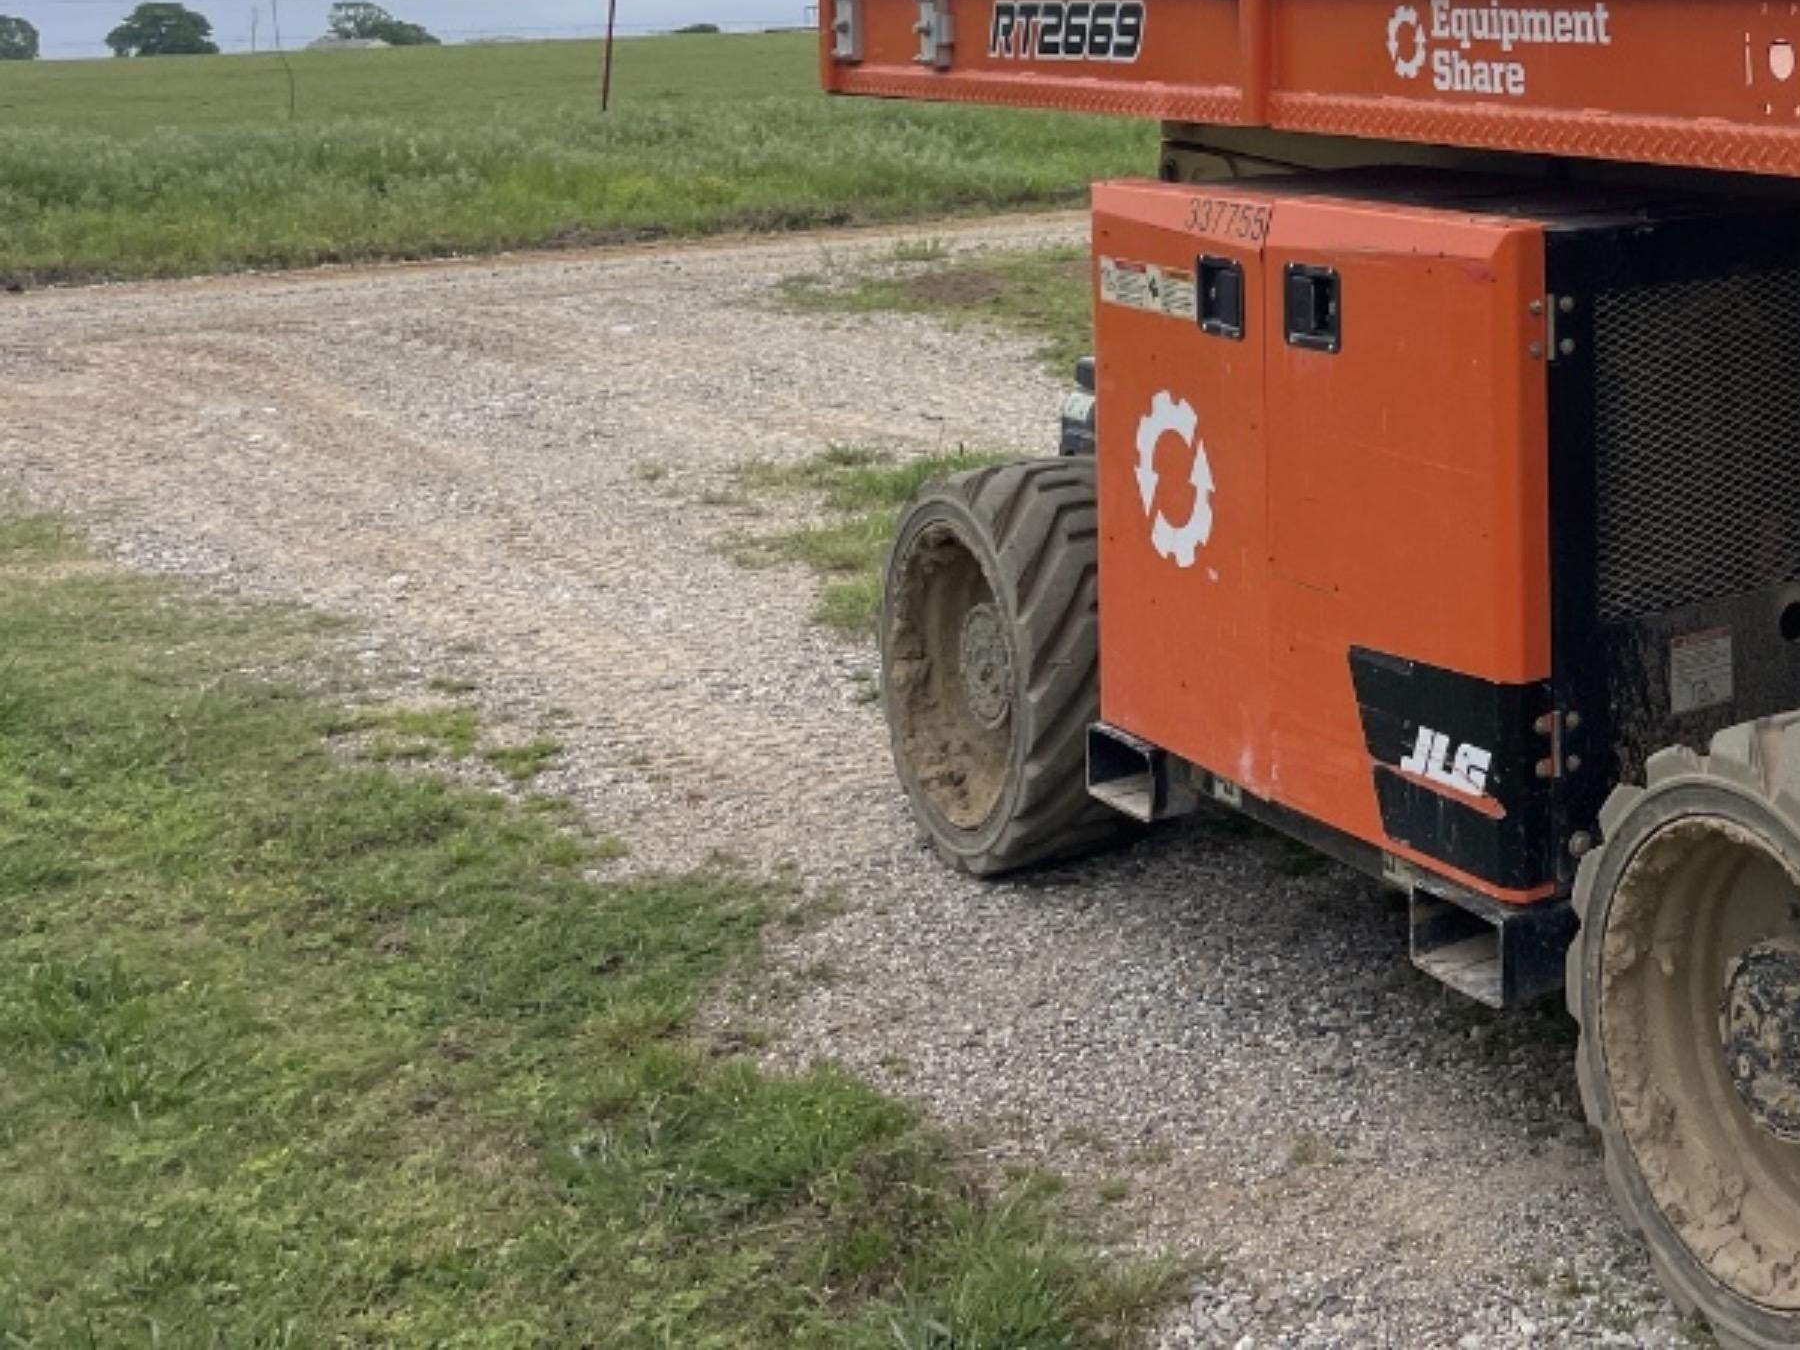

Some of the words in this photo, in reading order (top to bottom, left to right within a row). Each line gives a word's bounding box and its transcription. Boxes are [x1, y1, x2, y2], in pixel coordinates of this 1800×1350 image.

[987, 0, 1146, 64] RT2669
[1432, 47, 1525, 95] Share
[1400, 725, 1492, 796] JLG
